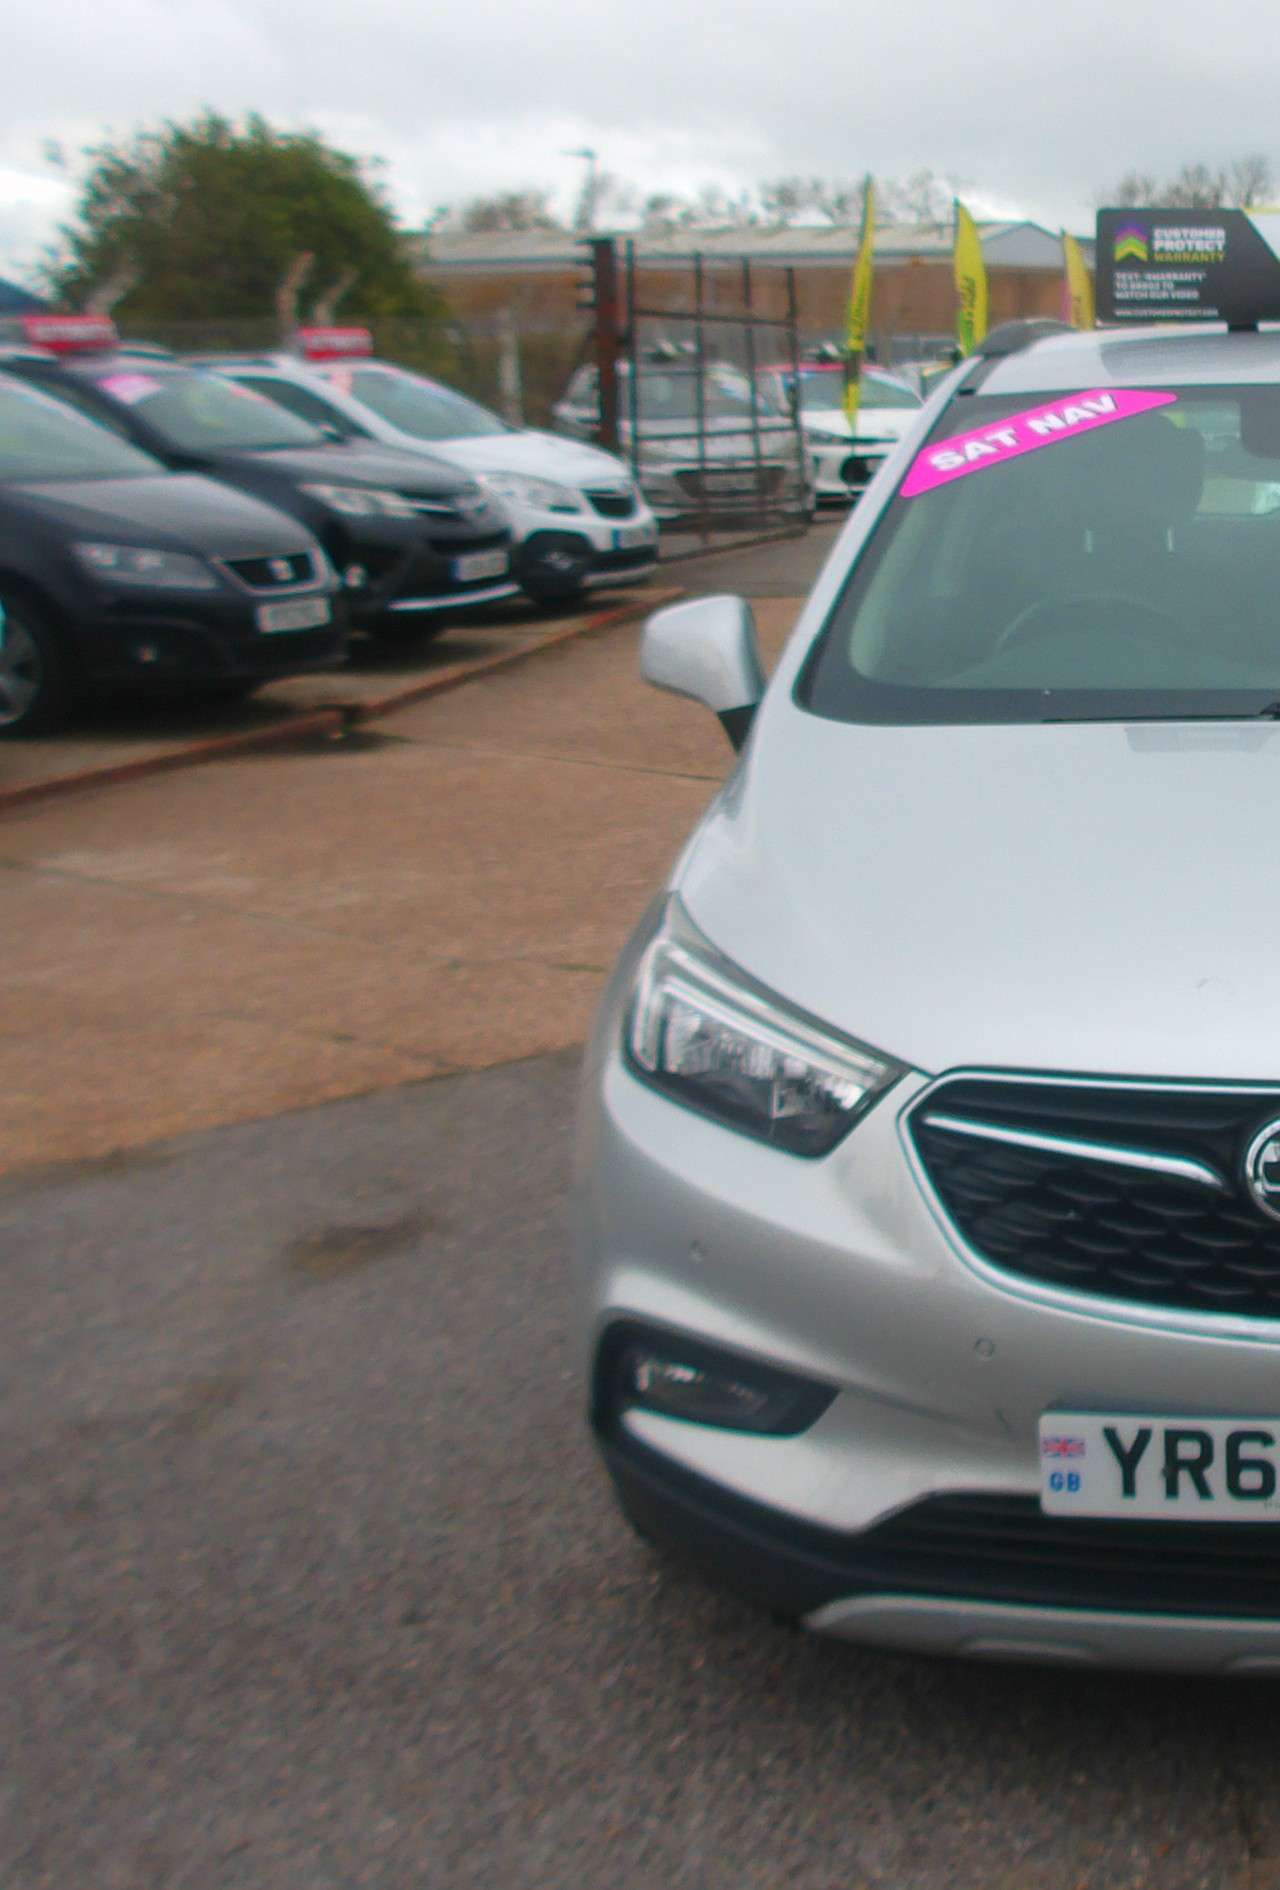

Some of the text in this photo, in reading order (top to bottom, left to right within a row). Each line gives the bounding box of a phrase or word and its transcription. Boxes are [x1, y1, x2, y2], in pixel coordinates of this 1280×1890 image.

[1153, 227, 1225, 240] CUSTOMER
[1153, 240, 1225, 252] PROTECT
[1154, 251, 1224, 263] WARRANTY
[929, 392, 1117, 472] SAT NAV
[1049, 1471, 1081, 1492] GB
